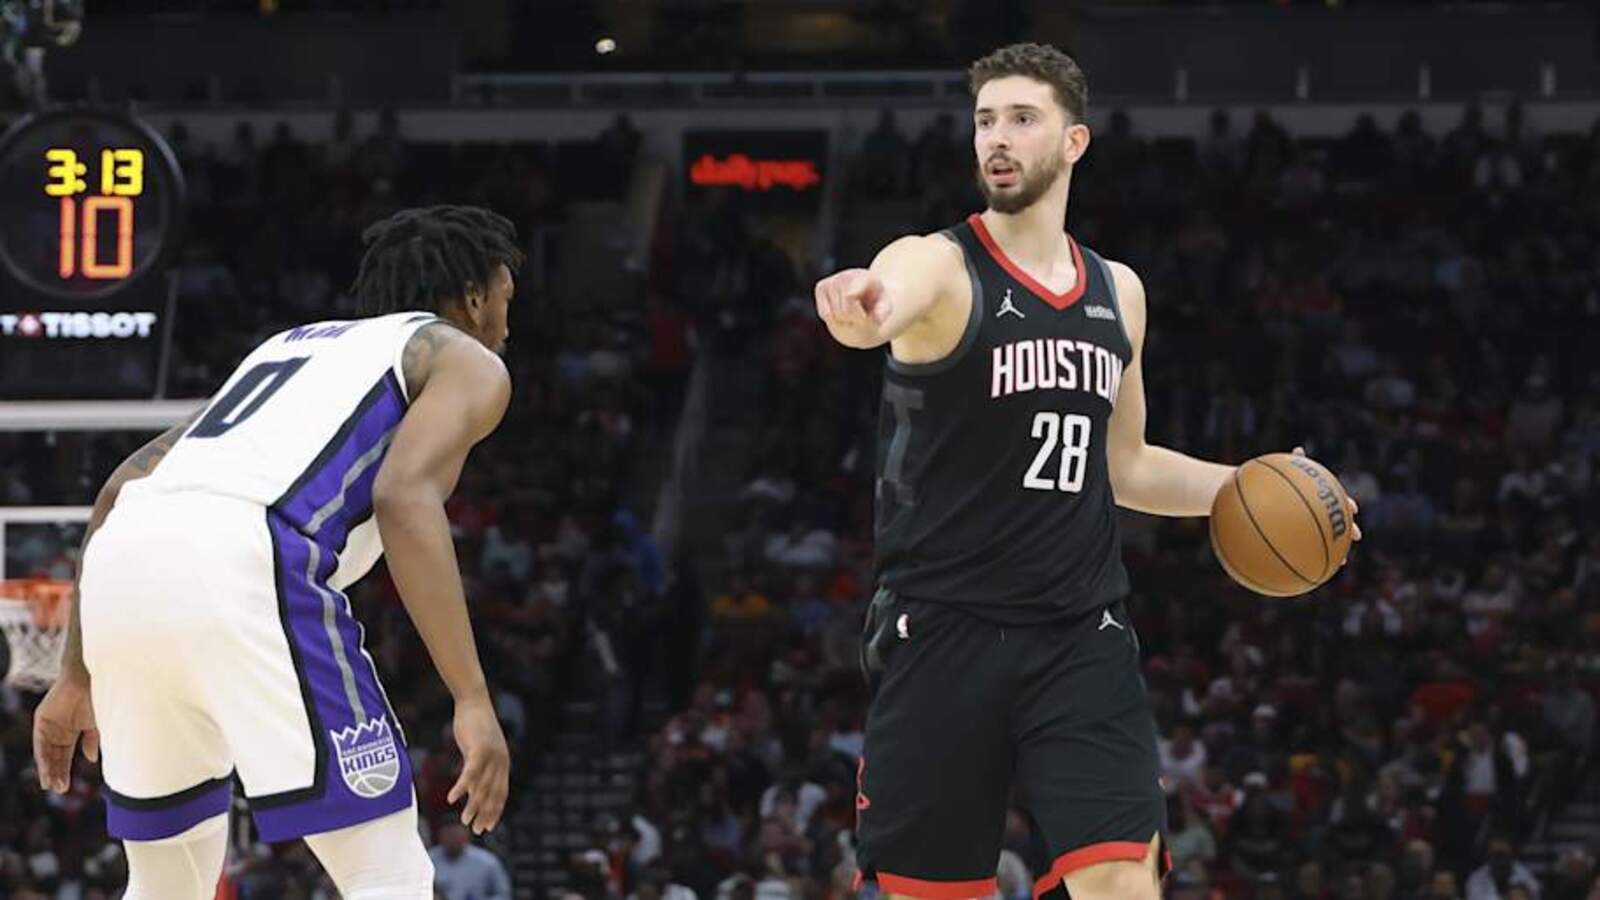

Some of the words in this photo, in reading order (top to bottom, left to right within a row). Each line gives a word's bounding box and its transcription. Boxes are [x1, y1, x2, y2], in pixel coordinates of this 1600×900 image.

[45, 149, 143, 196] 3:13
[59, 197, 134, 279] 10
[41, 312, 156, 337] TISSOT
[186, 354, 312, 439] 0
[991, 338, 1123, 407] HOUSTON
[1022, 411, 1091, 493] 28
[343, 746, 395, 775] KINGS
